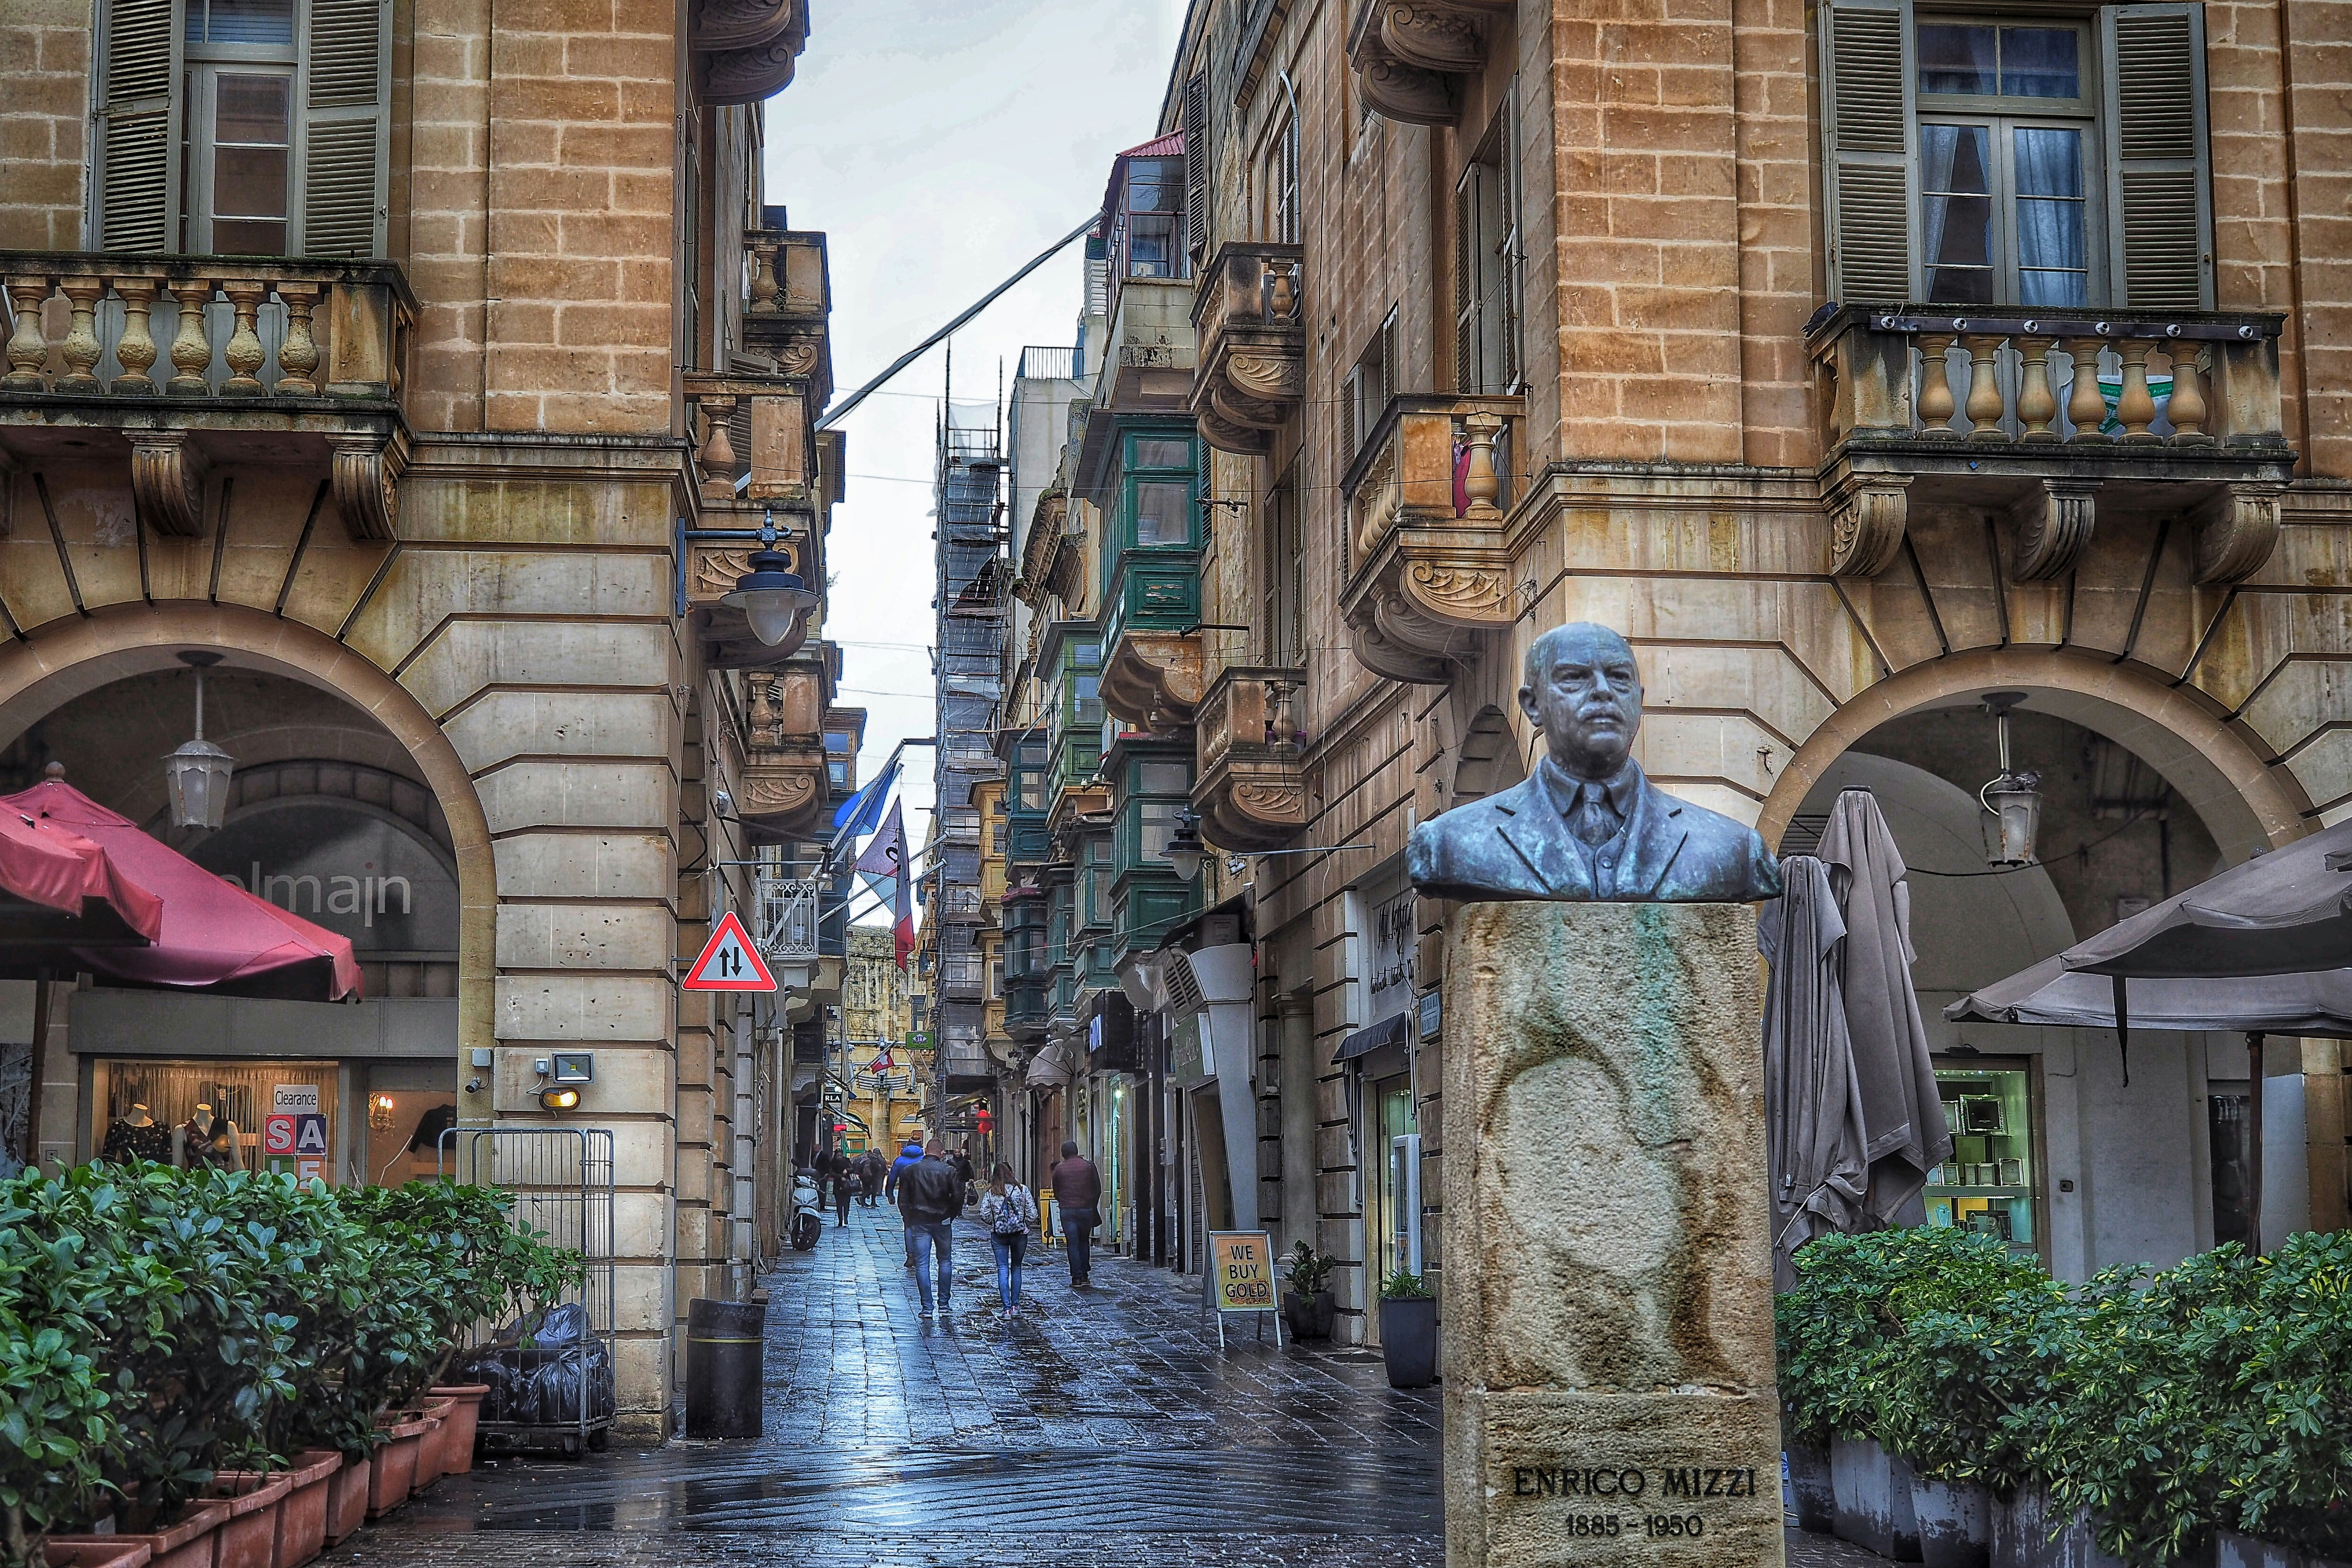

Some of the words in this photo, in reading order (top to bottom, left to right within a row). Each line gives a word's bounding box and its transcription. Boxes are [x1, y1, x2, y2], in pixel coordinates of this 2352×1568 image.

[275, 1091, 317, 1106] Clearance
[1230, 1245, 1254, 1260] WE
[1229, 1264, 1259, 1279] BUY
[1225, 1283, 1267, 1298] GOLD
[1513, 1466, 1645, 1496] ENRICO
[1662, 1467, 1756, 1497] MIZZI
